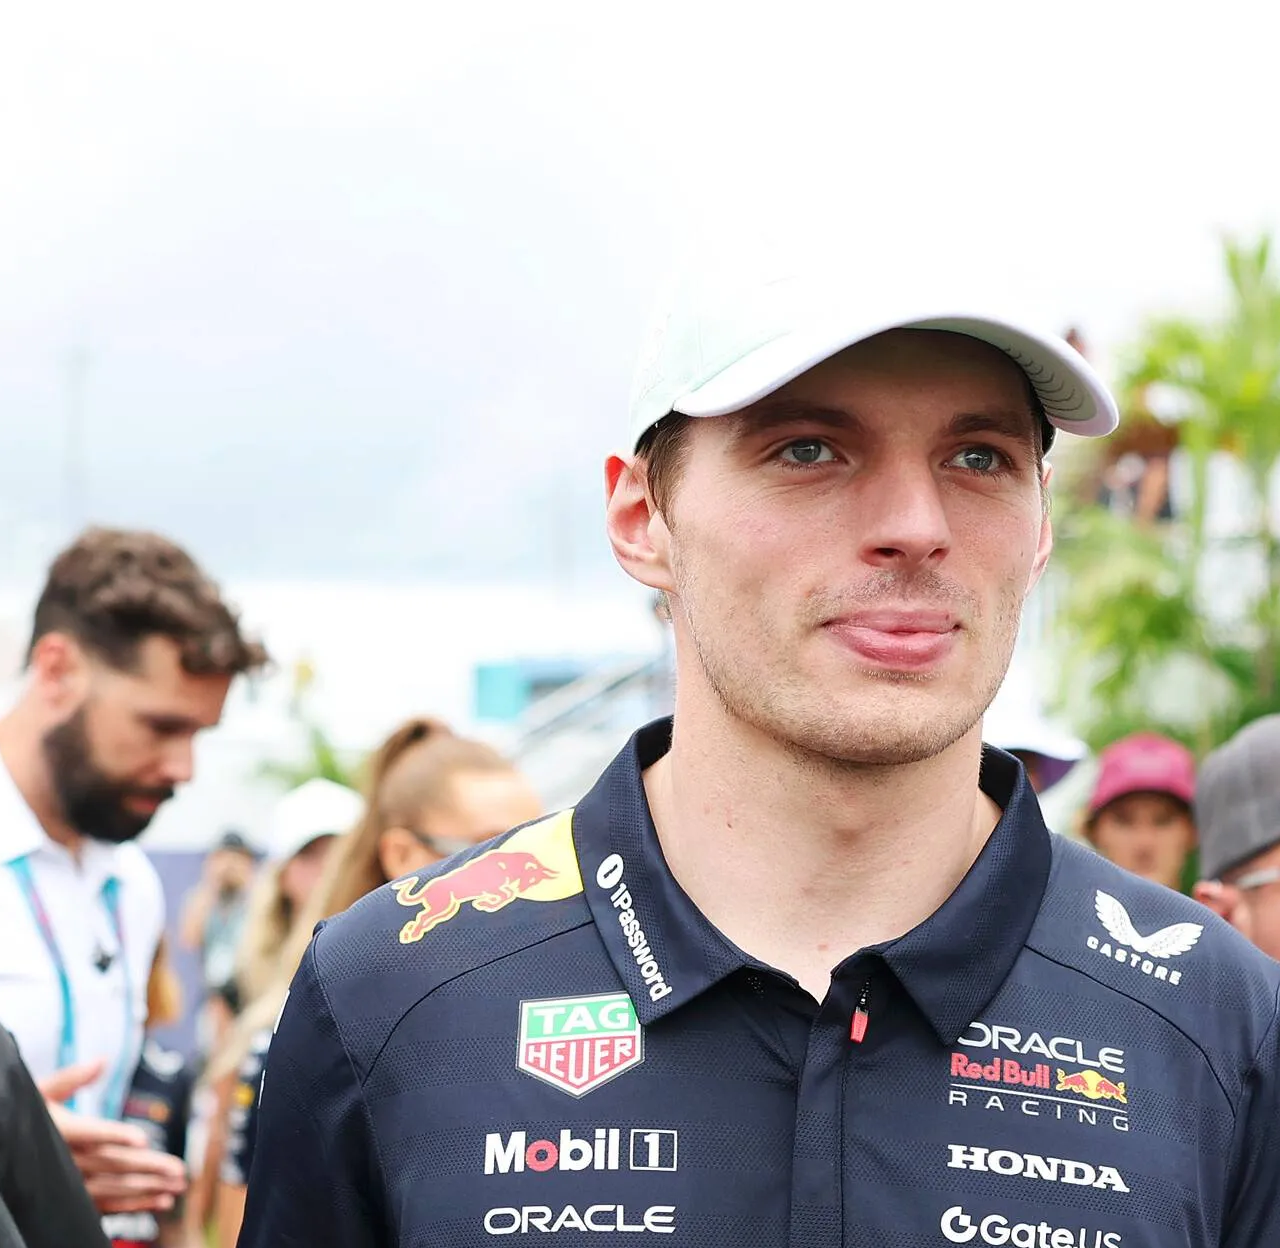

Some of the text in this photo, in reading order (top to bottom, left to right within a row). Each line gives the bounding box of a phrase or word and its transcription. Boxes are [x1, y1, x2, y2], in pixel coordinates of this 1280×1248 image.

[610, 883, 673, 1002] 1Password
[1086, 935, 1182, 986] CASTORE
[533, 1001, 630, 1035] TAG
[528, 1037, 634, 1085] HEUER
[948, 1090, 1129, 1132] RACING
[483, 1128, 620, 1174] Mobil
[947, 1144, 1130, 1193] HONDA
[484, 1204, 676, 1235] ORACLE
